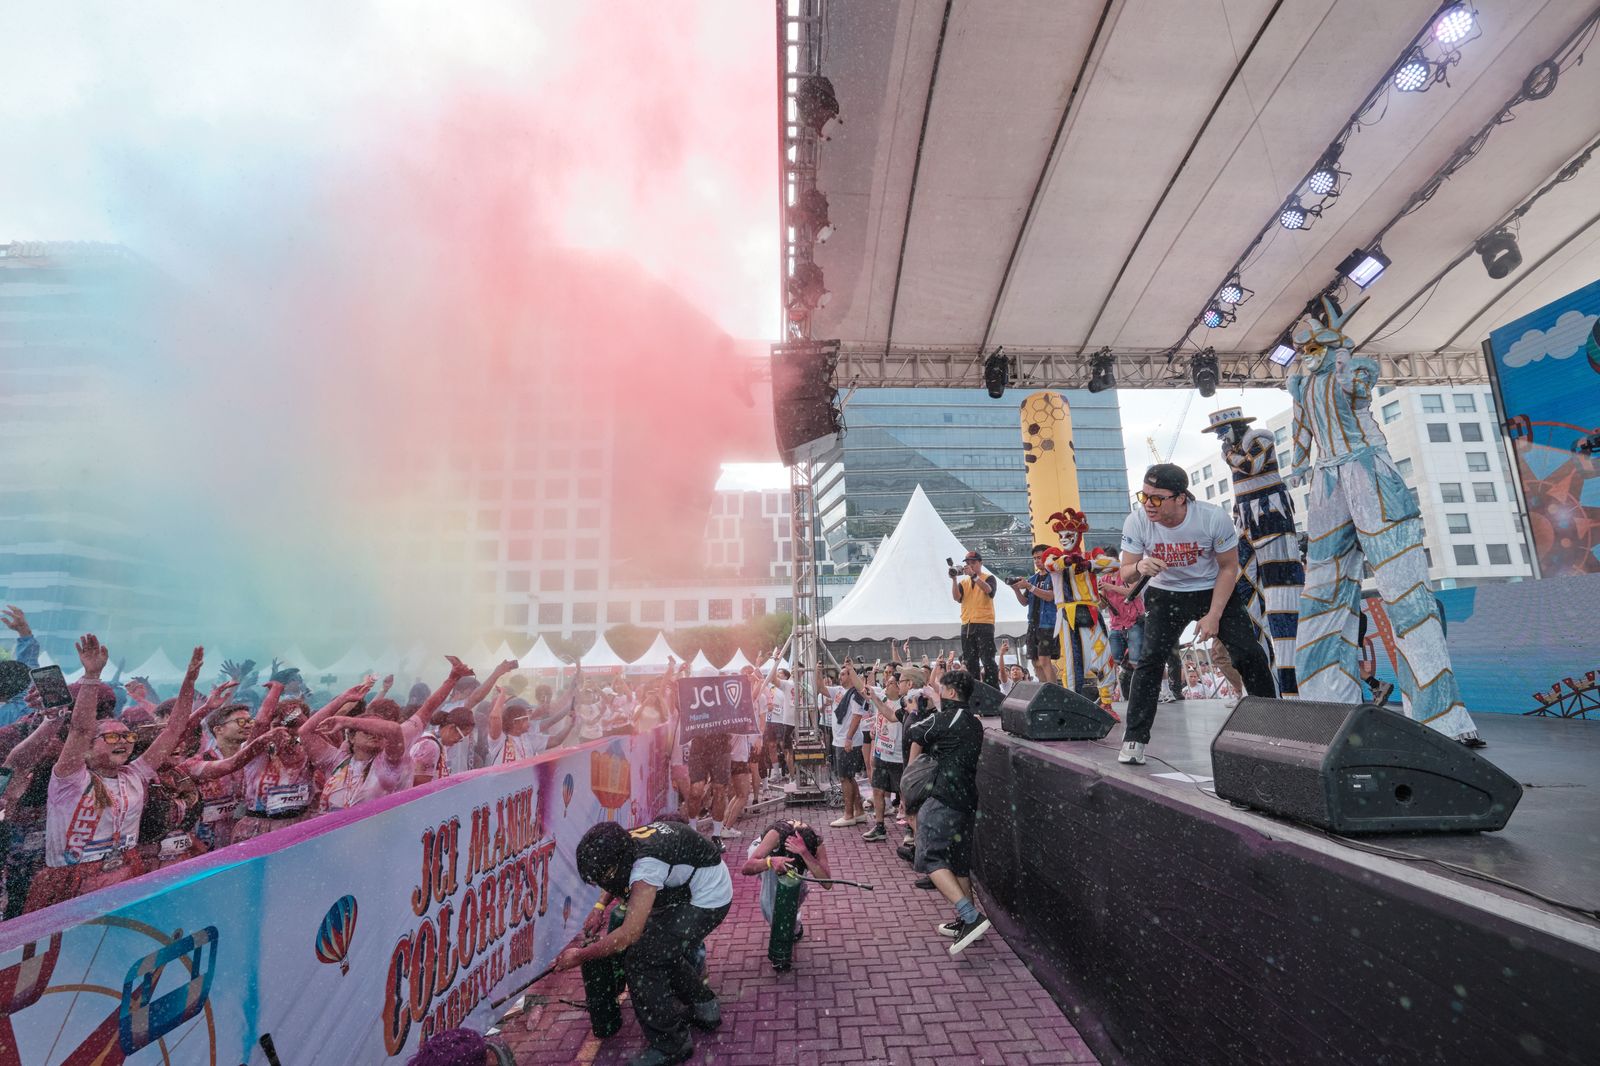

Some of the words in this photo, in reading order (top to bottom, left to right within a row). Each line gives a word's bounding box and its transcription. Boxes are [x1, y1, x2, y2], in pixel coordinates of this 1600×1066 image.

[1166, 541, 1198, 553] MANILA
[689, 685, 721, 710] JCI
[685, 720, 721, 731] UNIVERSITY
[173, 834, 191, 849] 758
[411, 814, 461, 917] JCI
[465, 784, 544, 886] MANILA
[382, 832, 556, 1057] COLORFEST
[419, 942, 507, 1048] CARNIVAL
